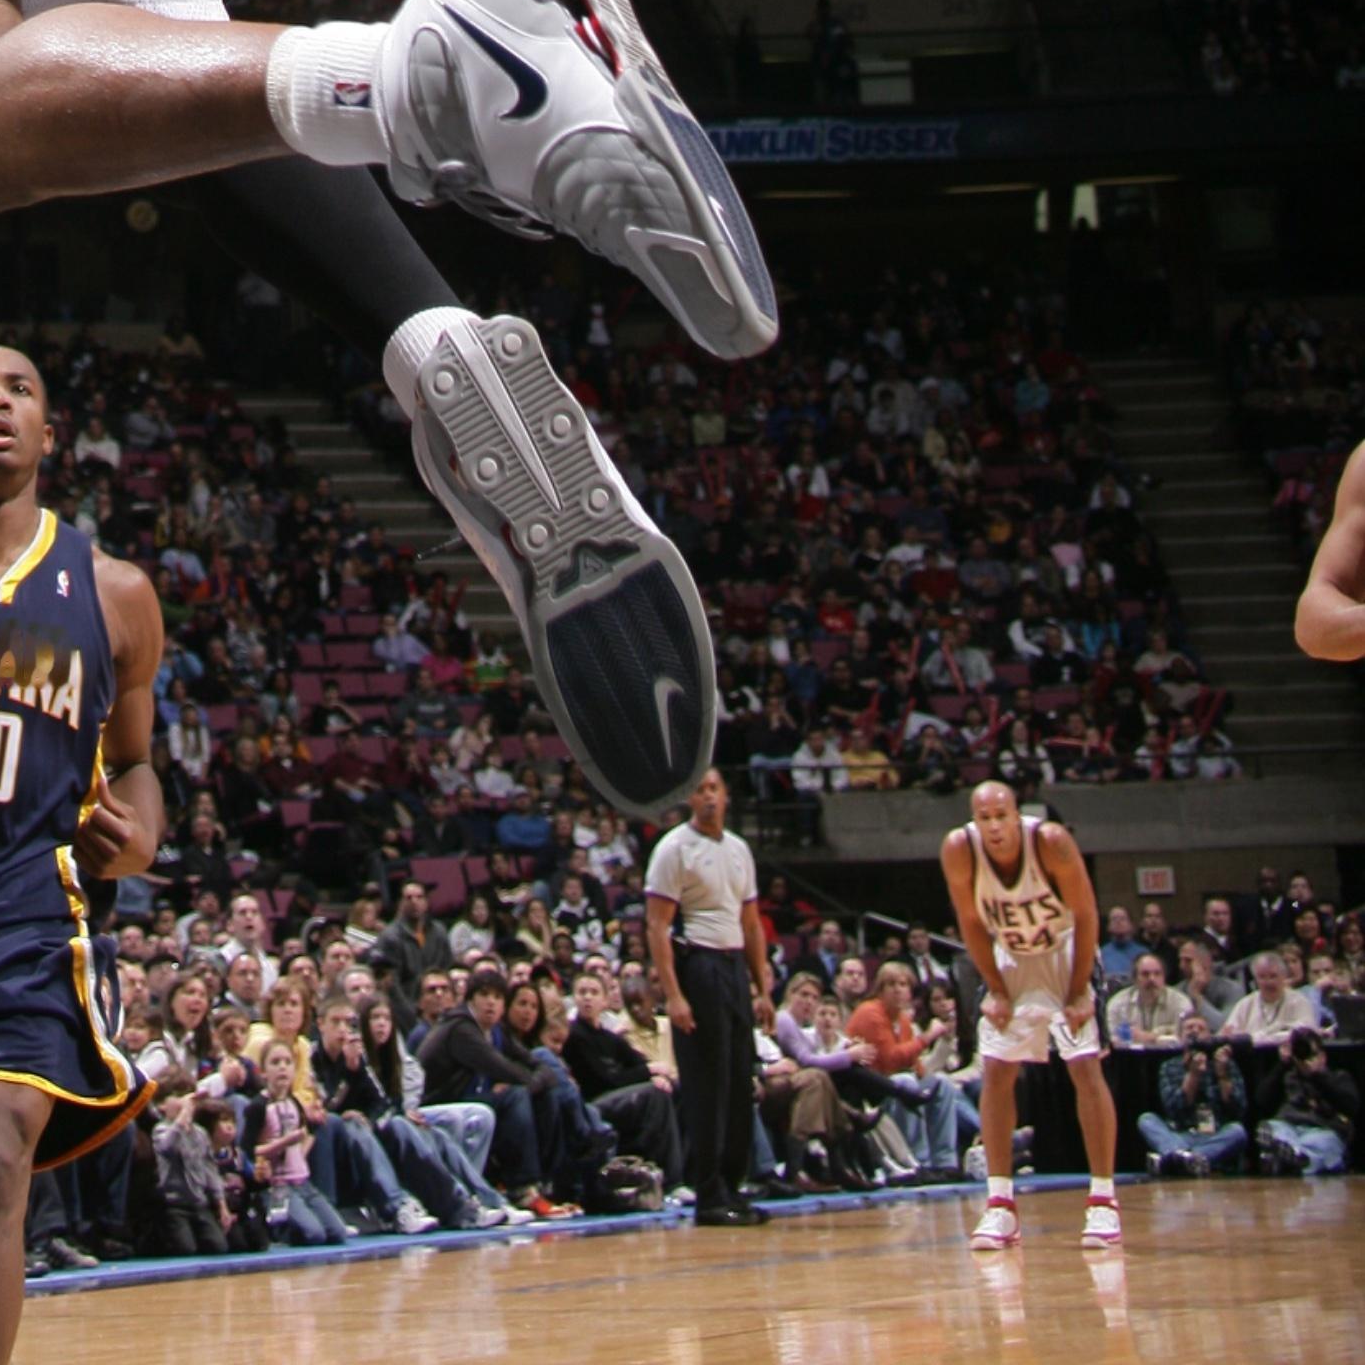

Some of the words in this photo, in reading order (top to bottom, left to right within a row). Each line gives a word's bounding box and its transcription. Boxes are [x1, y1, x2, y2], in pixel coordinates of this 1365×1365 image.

[709, 124, 817, 158] ANKLIN
[826, 121, 957, 158] SUSSEX
[981, 891, 1061, 929] NETS
[1003, 925, 1054, 953] 24
